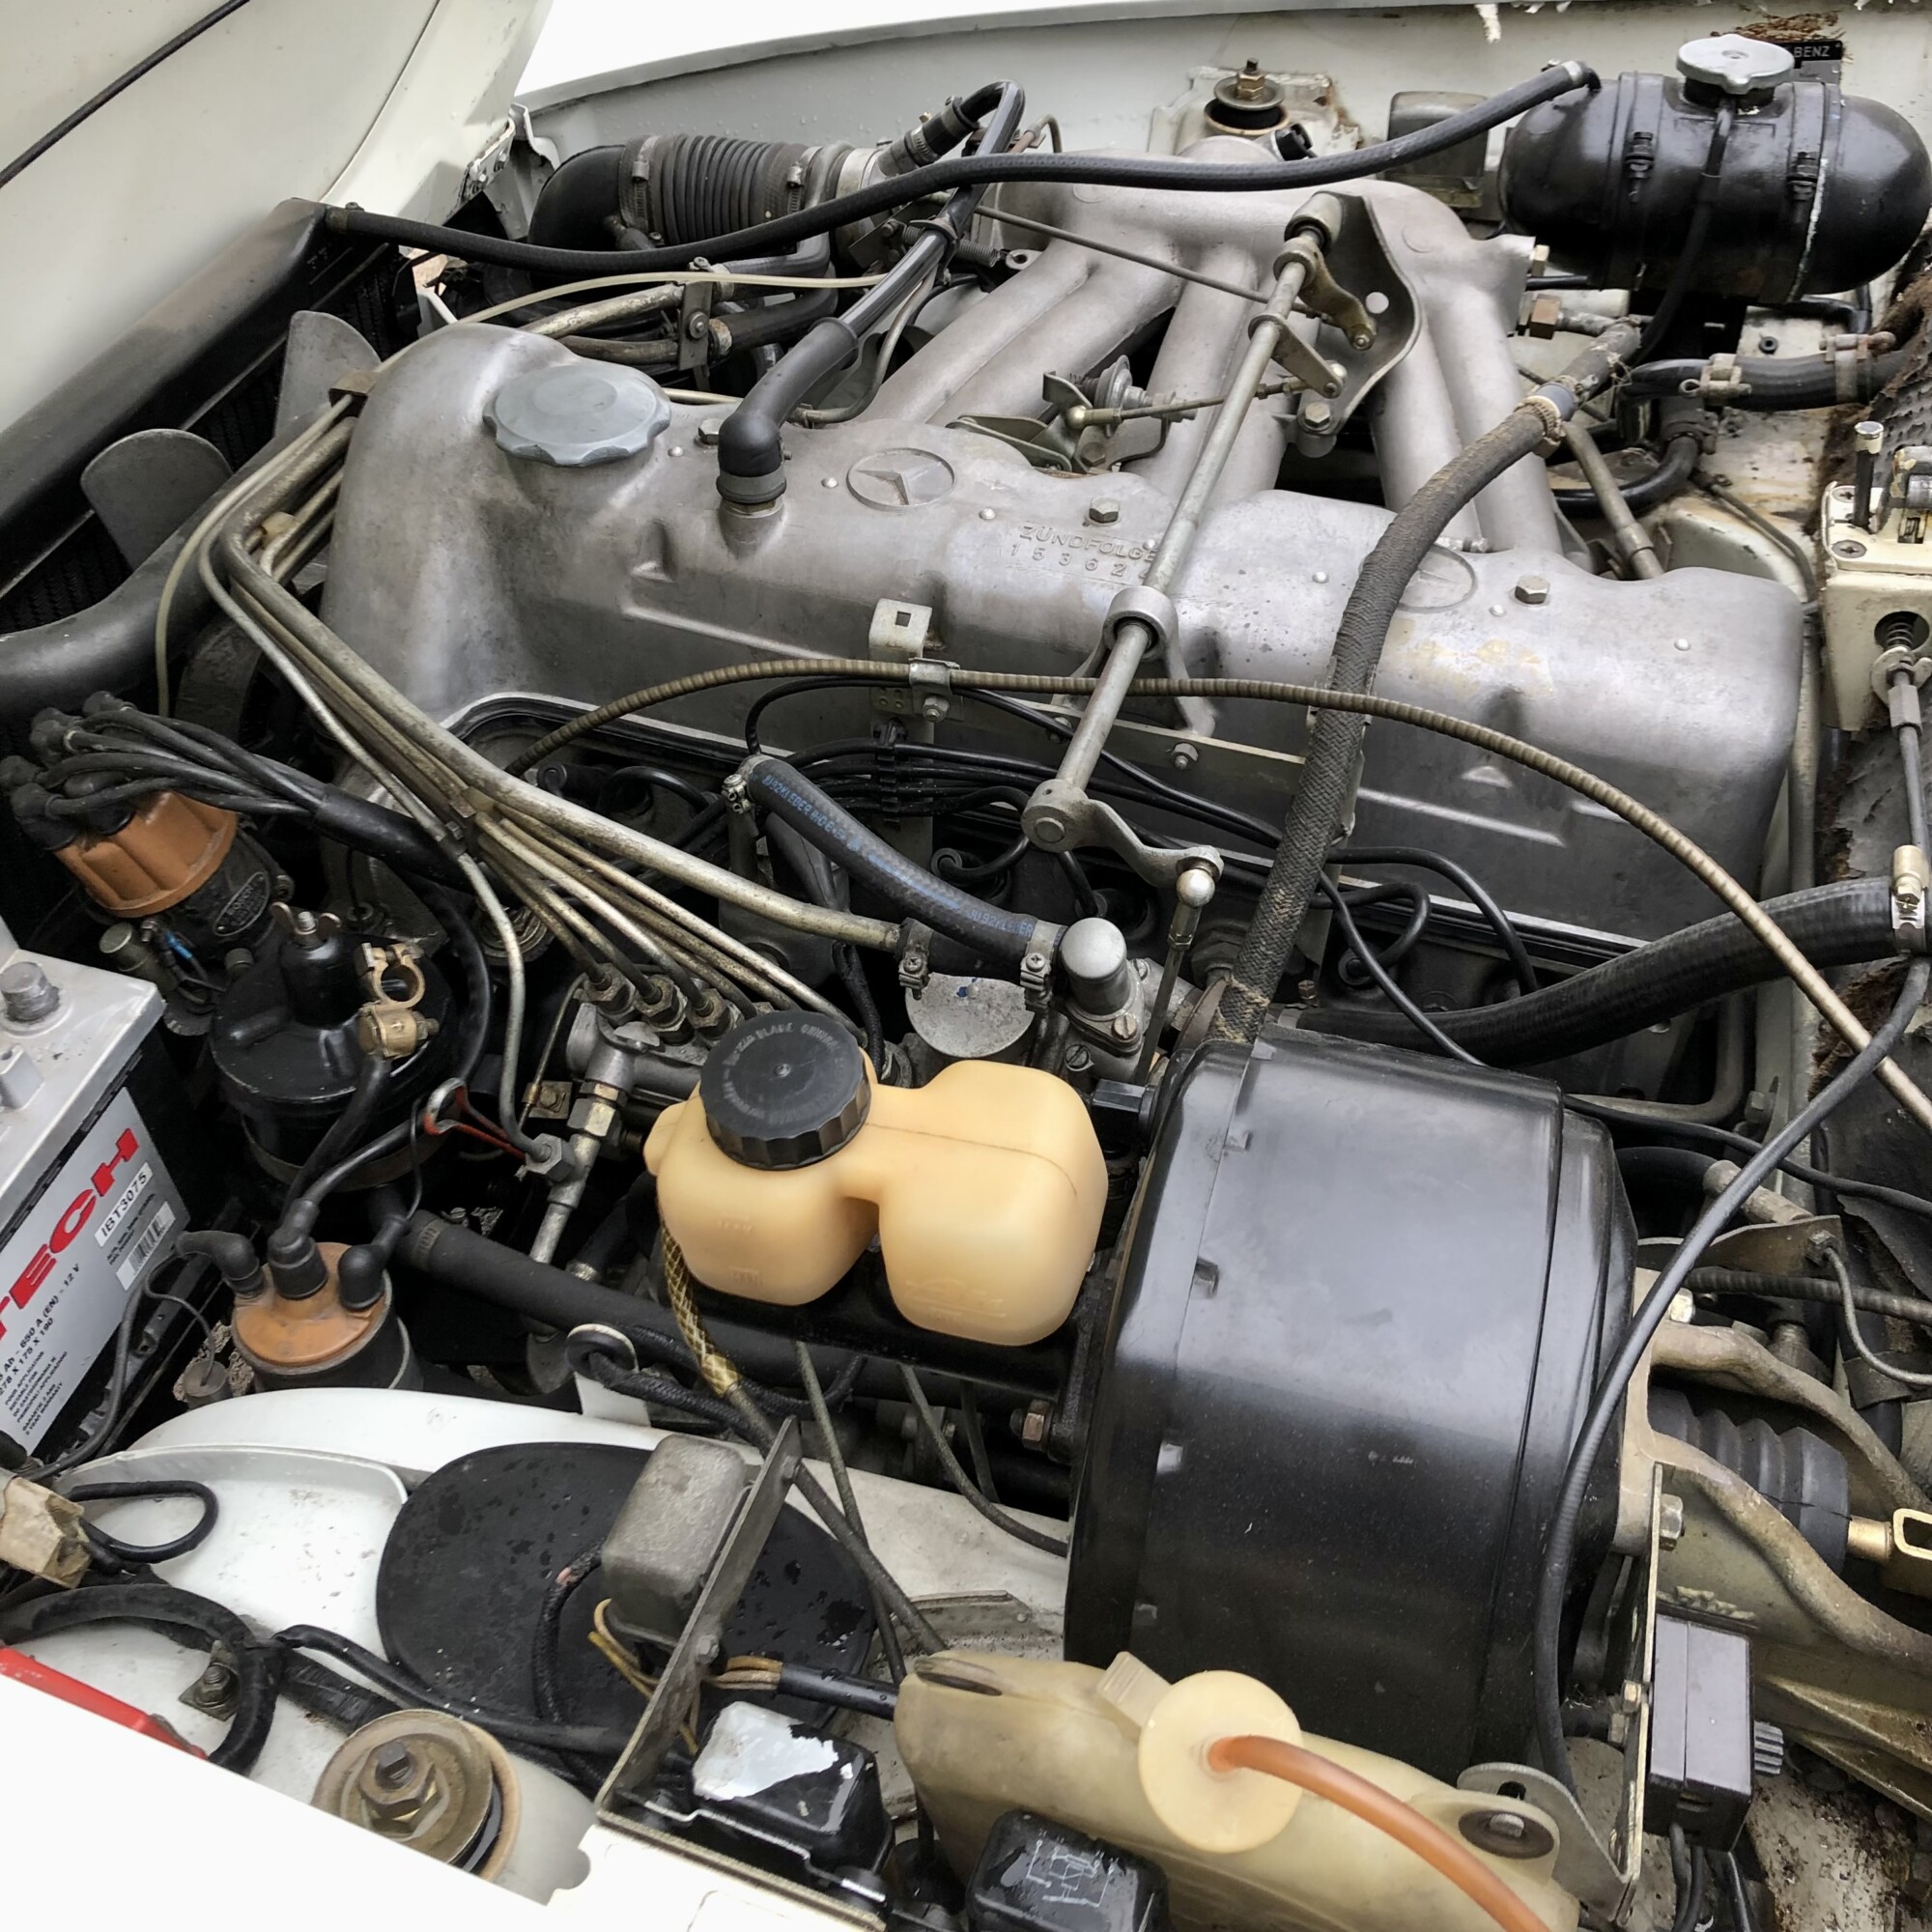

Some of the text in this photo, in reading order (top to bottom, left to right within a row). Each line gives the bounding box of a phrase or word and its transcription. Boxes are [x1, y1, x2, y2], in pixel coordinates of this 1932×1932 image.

[1794, 45, 1831, 58] BENZ
[1020, 525, 1157, 563] ZÜNDFOLGE
[100, 1170, 147, 1237] IBT3075
[20, 1327, 36, 1348] 650
[43, 1295, 59, 1318] (EN)
[64, 1273, 74, 1286] 12
[40, 1318, 53, 1335] 190
